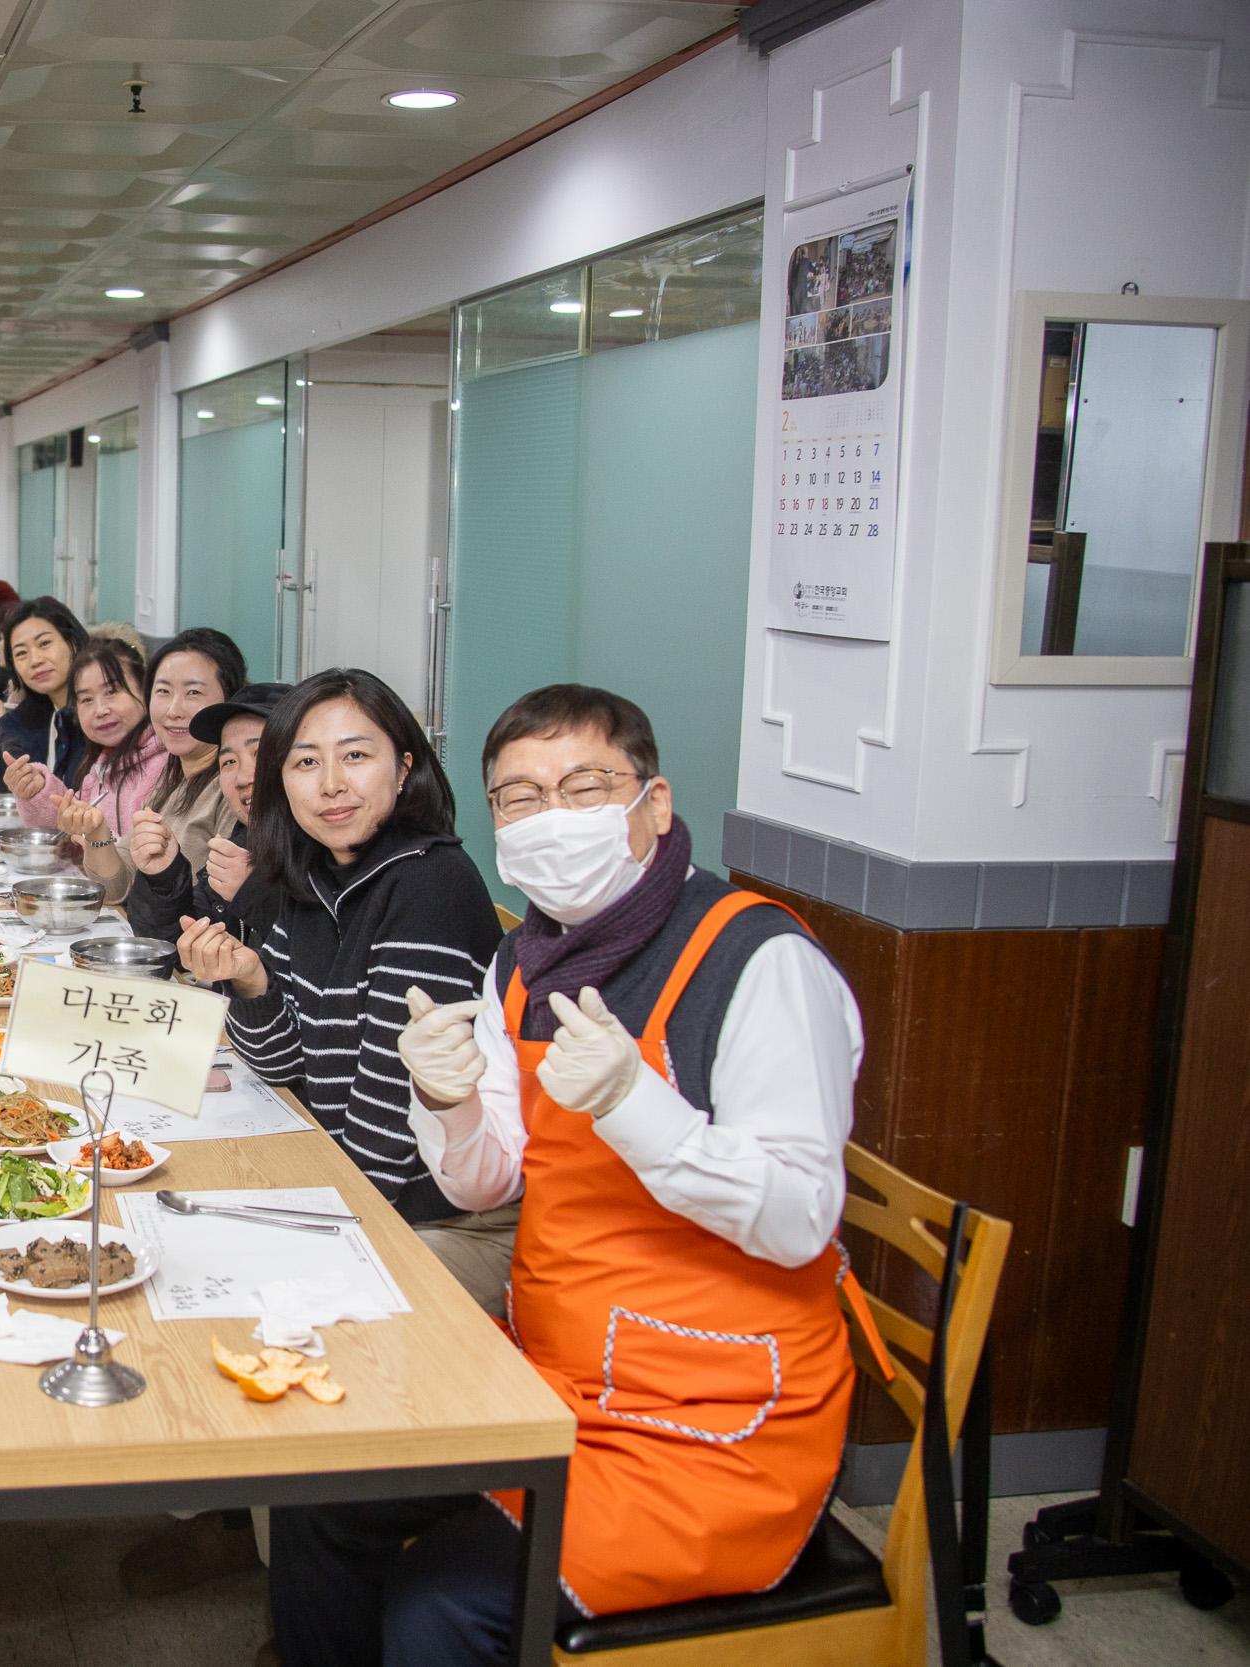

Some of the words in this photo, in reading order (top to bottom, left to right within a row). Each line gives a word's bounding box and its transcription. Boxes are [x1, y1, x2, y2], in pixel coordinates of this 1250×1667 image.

[782, 411, 789, 432] 2
[784, 450, 786, 461] 1
[797, 449, 801, 460] 2
[812, 448, 816, 459] 3
[826, 447, 830, 458] 4
[840, 445, 845, 457] 5
[856, 445, 861, 456] 6
[874, 444, 879, 456] 7
[782, 474, 785, 485] 8
[795, 474, 799, 485] 9
[810, 473, 816, 485] 10
[824, 473, 829, 484] 11
[838, 472, 845, 483] 12
[854, 471, 861, 483] 13
[872, 471, 881, 483] 14
[780, 499, 786, 510] 15
[793, 499, 799, 510] 16
[808, 498, 814, 510] 17
[822, 498, 828, 510] 18
[837, 498, 843, 510] 19
[851, 498, 860, 510] 20
[869, 498, 878, 510] 21
[778, 524, 784, 535] 22
[790, 524, 798, 535] 23
[804, 524, 812, 535] 24
[819, 524, 827, 535] 25
[833, 524, 841, 536] 26
[849, 524, 859, 536] 27
[868, 524, 878, 536] 28
[815, 585, 847, 597] 한국중앙교회
[63, 986, 182, 1035] 다문화
[68, 1040, 148, 1085] 가족
